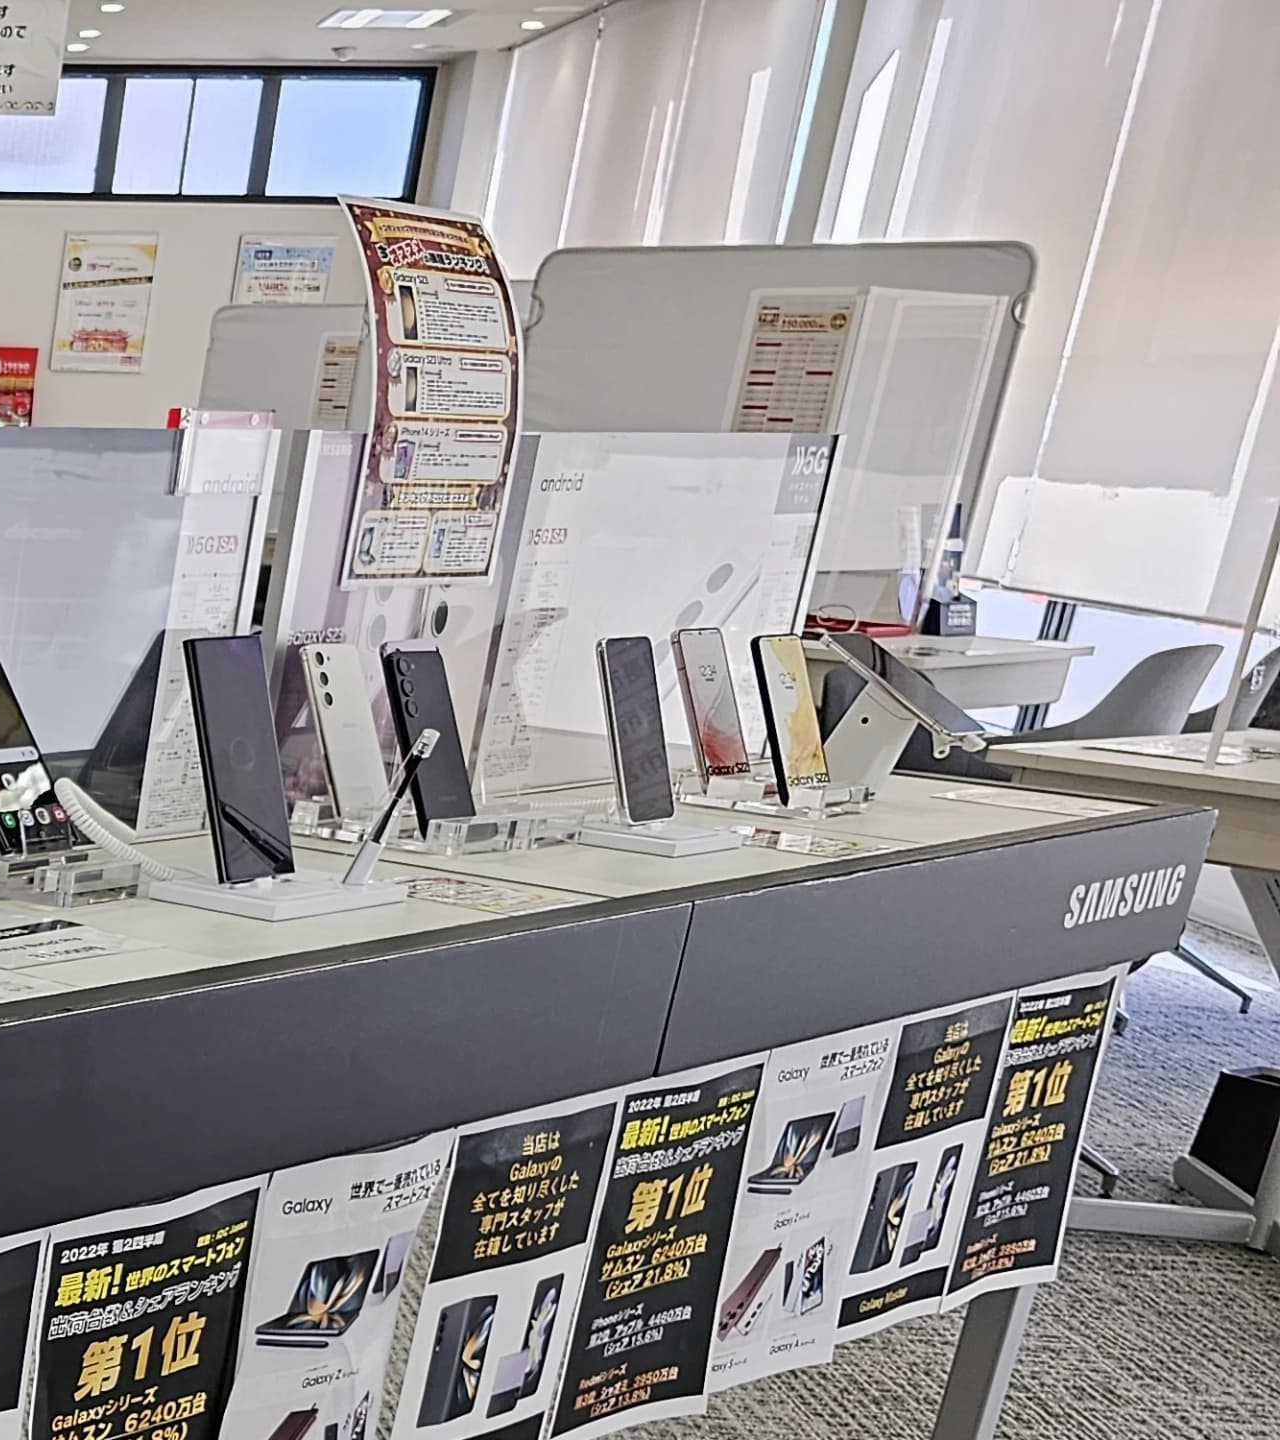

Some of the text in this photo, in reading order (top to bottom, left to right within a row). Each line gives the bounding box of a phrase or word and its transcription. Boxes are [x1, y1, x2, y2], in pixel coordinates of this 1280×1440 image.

[541, 473, 584, 491] android
[1063, 865, 1186, 930] SAMSUNG
[778, 1067, 810, 1084] Galaxy
[521, 1131, 560, 1158] 当店は
[510, 1156, 562, 1182] Galaxyの
[282, 1196, 334, 1217] Galaxy
[470, 1171, 581, 1214] 全てを知り尽くした
[625, 1162, 714, 1235] 第1位
[478, 1197, 565, 1236] 専門スタッフが
[60, 1242, 109, 1264] 2022年
[473, 1221, 560, 1260] 在籍しています
[54, 1237, 245, 1307] 最新! 世界のスマートフォン
[73, 1311, 208, 1402] 第1位
[52, 1386, 159, 1432] Galaxyシリーズ
[124, 1392, 207, 1433] 6240万台
